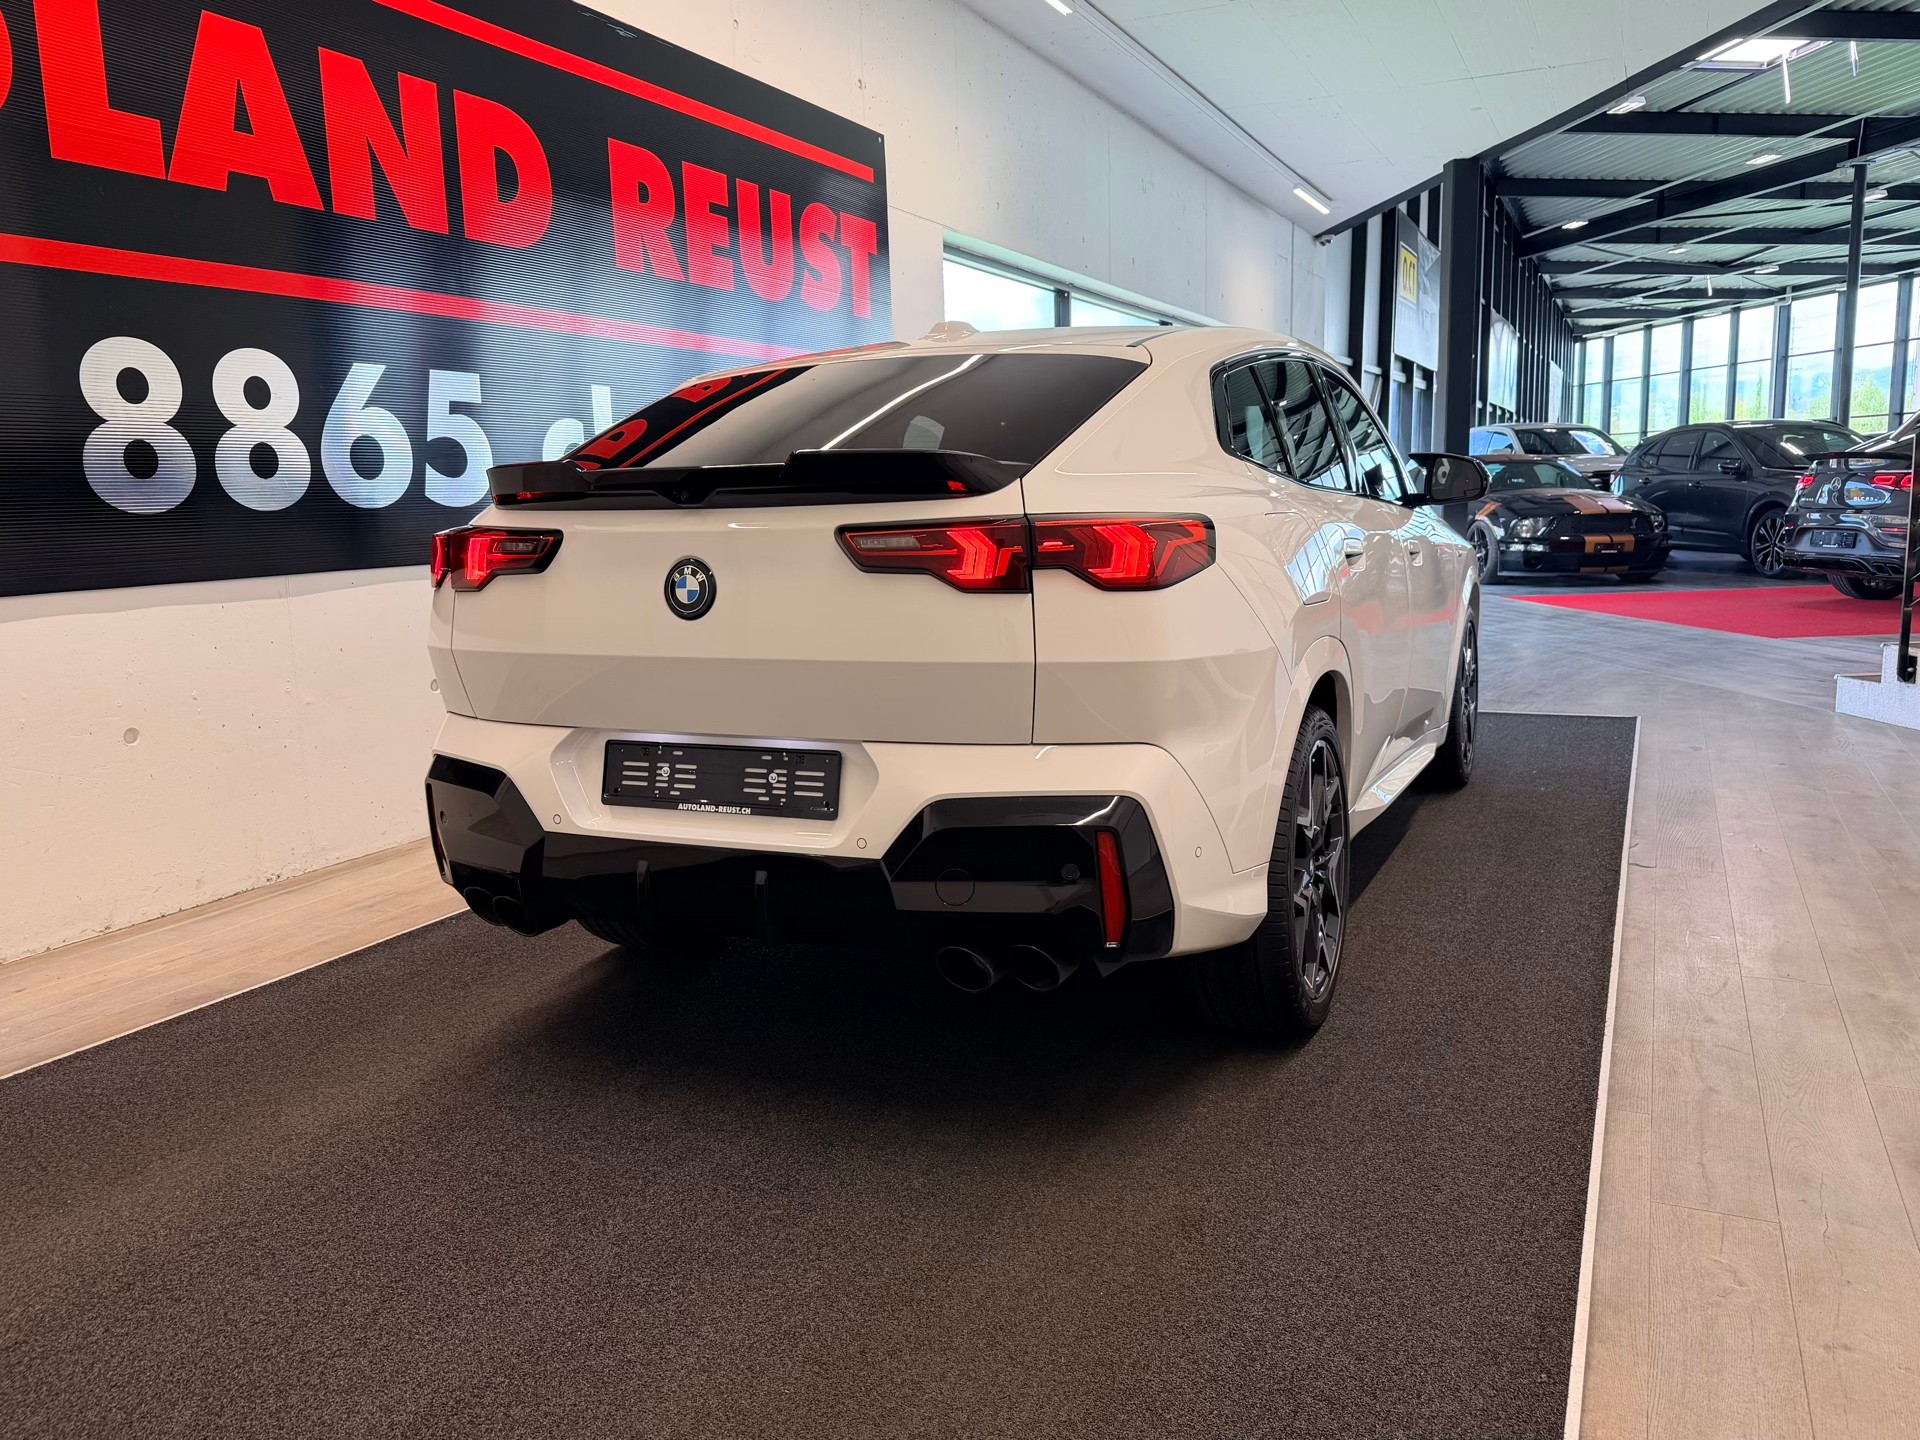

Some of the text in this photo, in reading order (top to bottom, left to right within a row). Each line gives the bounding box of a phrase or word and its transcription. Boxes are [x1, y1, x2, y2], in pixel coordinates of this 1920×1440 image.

[0, 0, 880, 319] LAND REUST
[79, 336, 494, 515] 8865
[673, 567, 705, 582] BMW
[677, 803, 751, 815] AUTOLAND-REUST.CH
